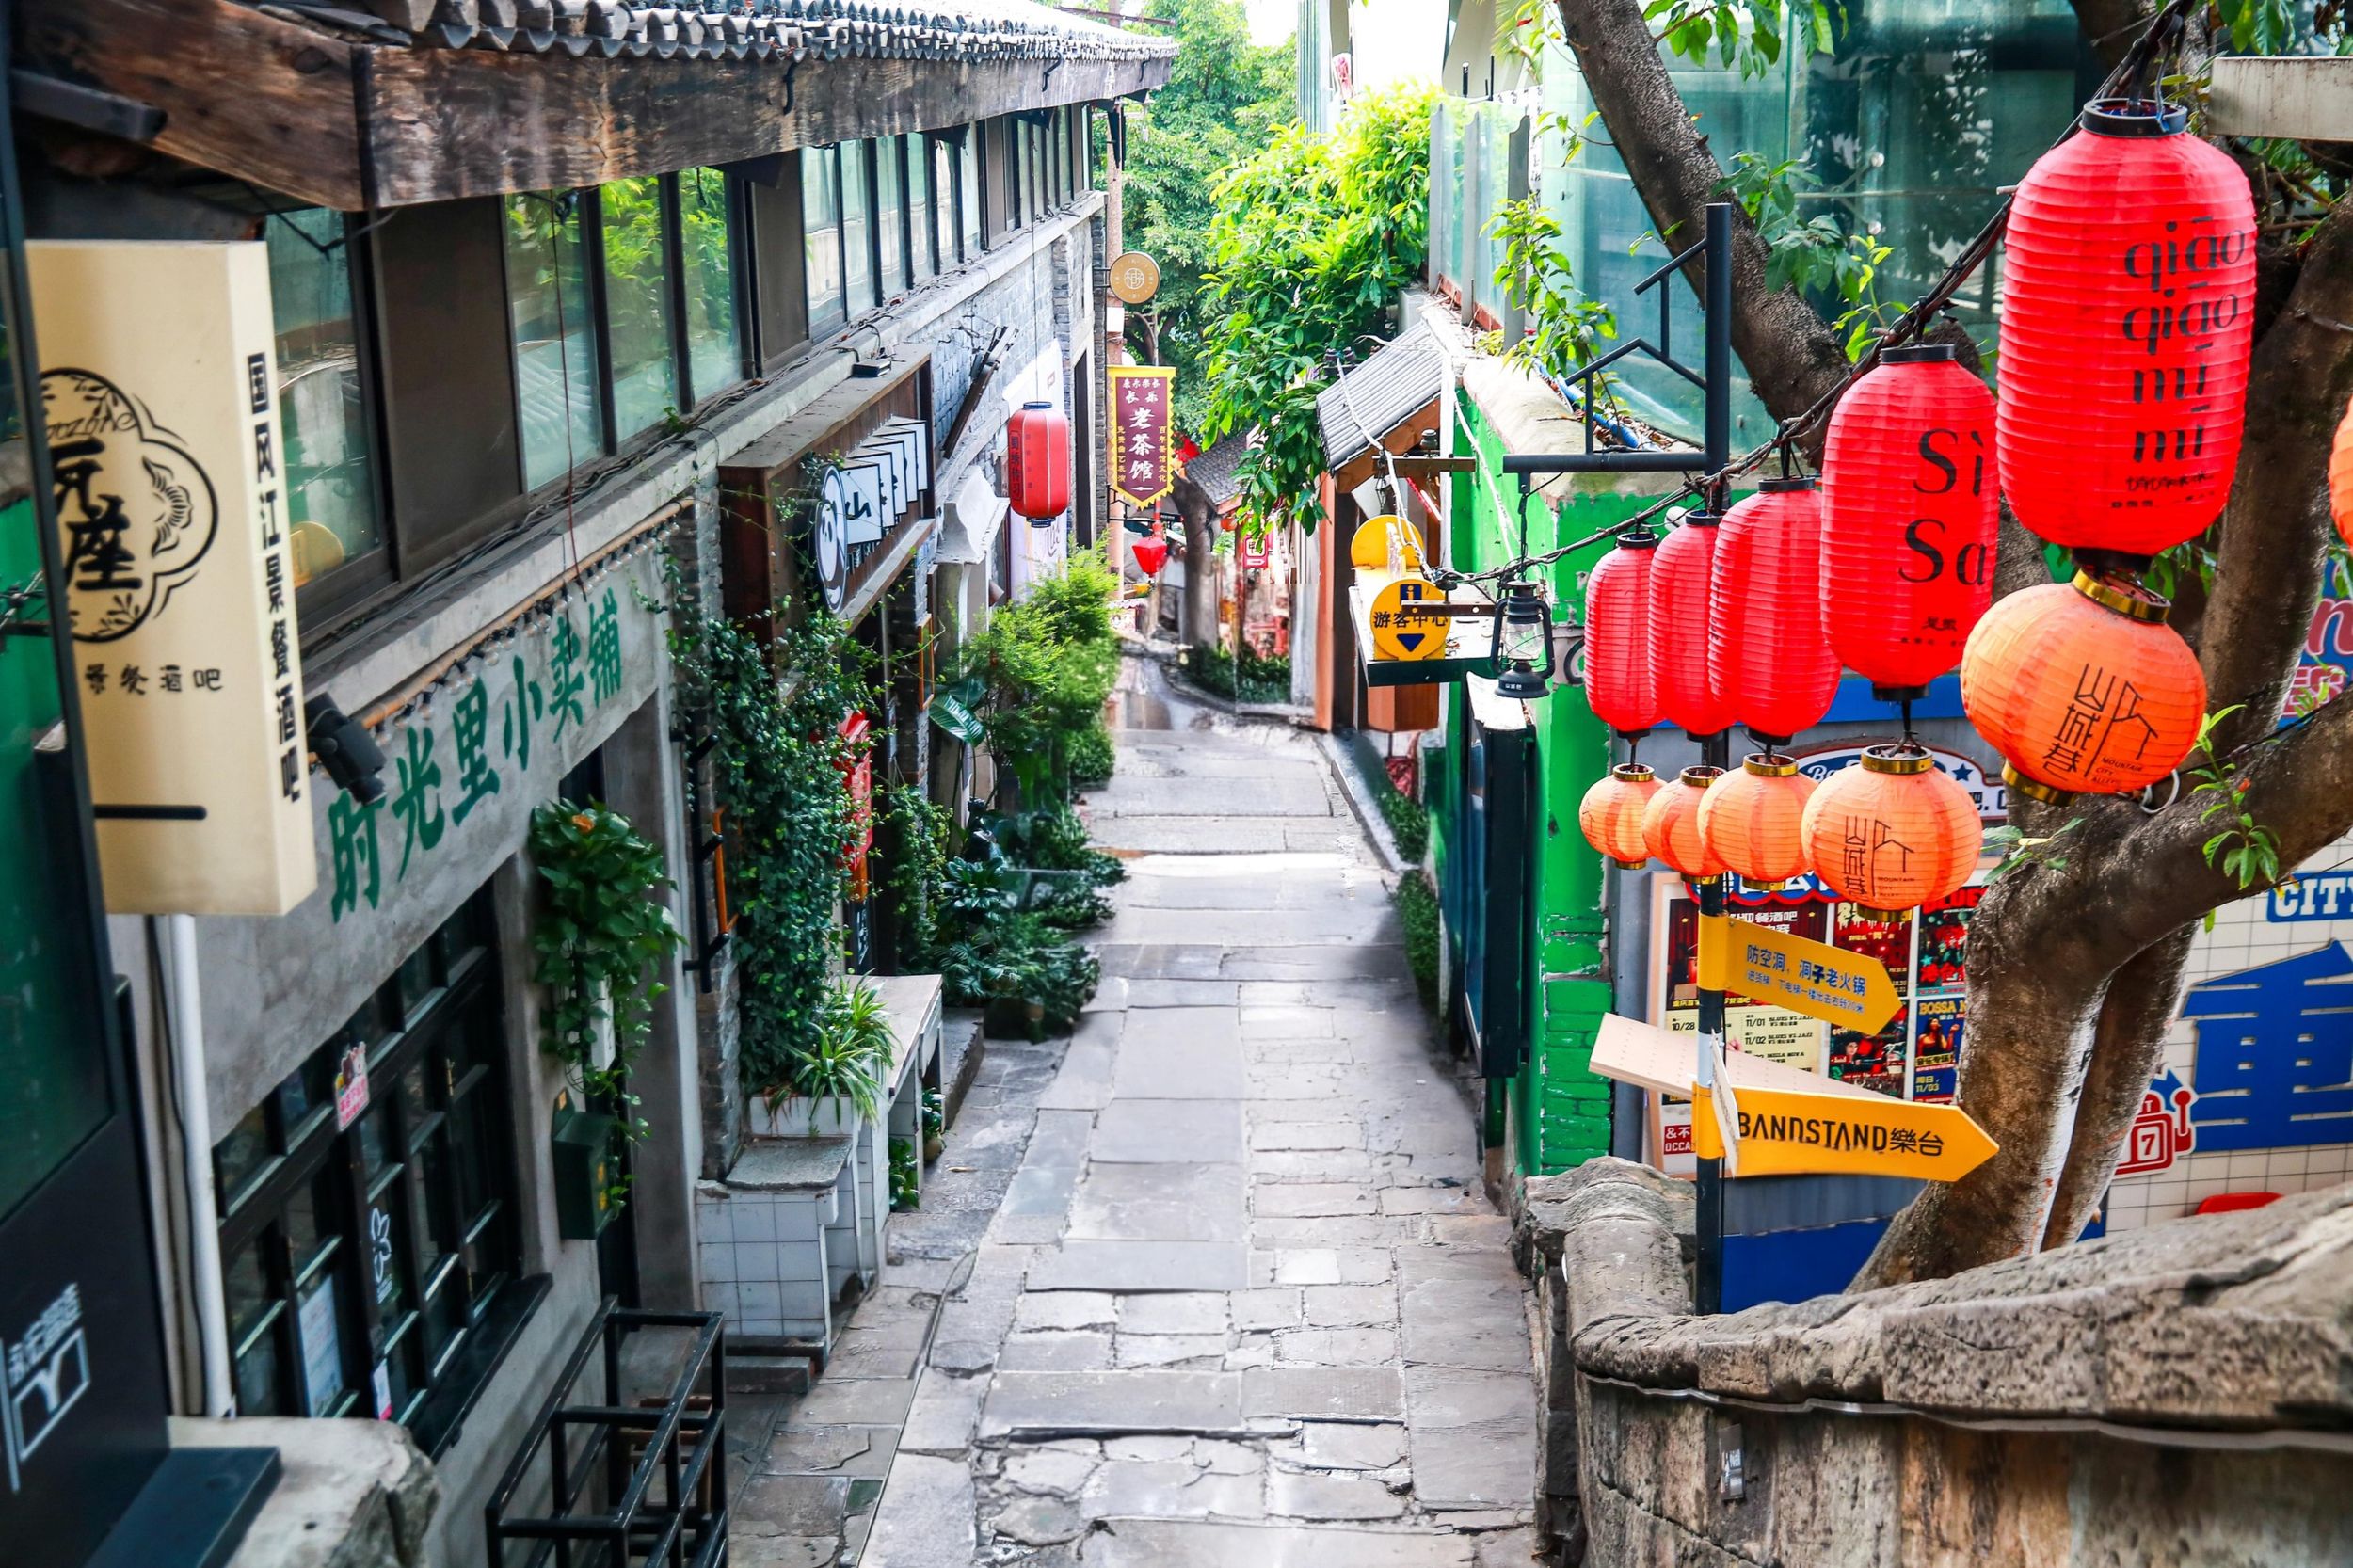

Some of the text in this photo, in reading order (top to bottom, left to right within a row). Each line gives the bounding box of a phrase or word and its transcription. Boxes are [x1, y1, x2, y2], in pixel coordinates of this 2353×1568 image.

[1129, 407, 1156, 482] 老茶馆
[1373, 610, 1449, 629] 游客中心
[328, 587, 623, 923] 时光里小卖铺
[1919, 1001, 1957, 1015] BOSSA
[1672, 1021, 1695, 1031] 10/28
[1746, 1018, 1766, 1027] 11/01
[1745, 1035, 1766, 1045] 11/02
